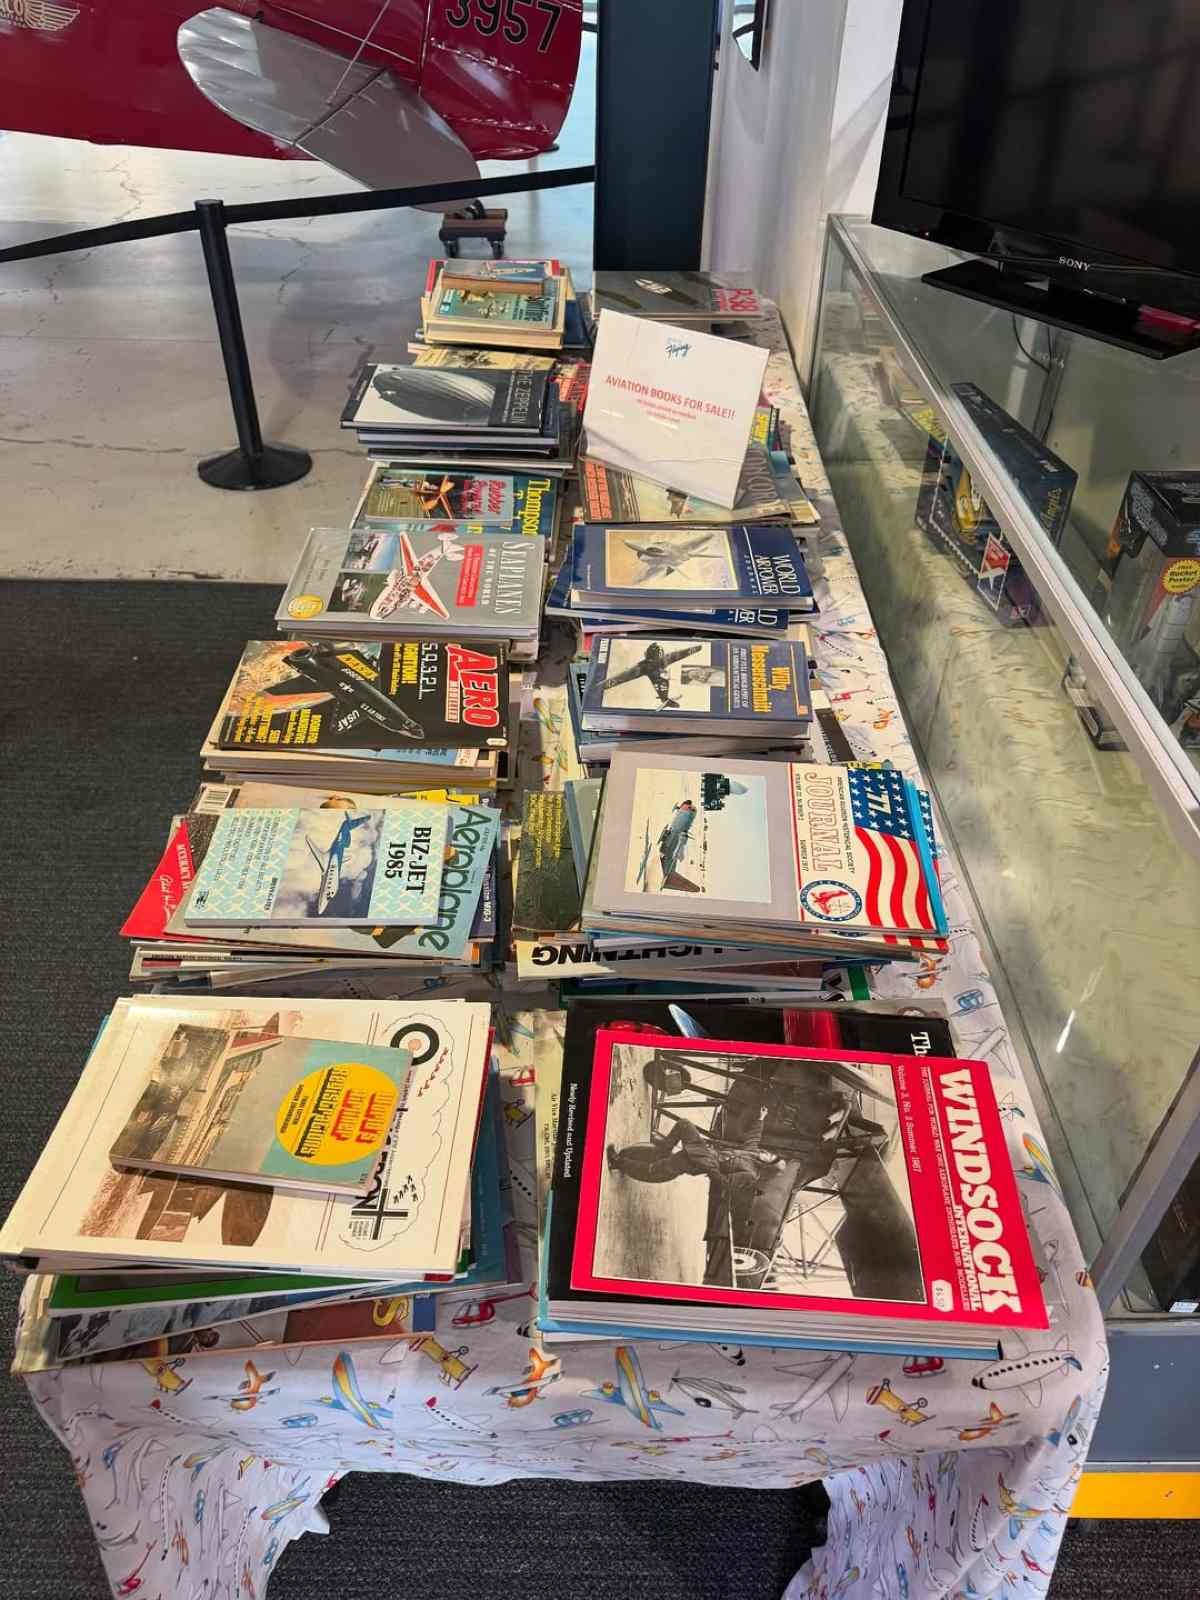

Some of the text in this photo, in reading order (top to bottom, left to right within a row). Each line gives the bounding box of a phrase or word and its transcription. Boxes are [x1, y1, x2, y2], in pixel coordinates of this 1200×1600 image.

[445, 0, 562, 53] 3957
[1058, 256, 1090, 271] SONY
[511, 387, 531, 424] ZEPPELIN
[606, 375, 649, 397] AVIATION
[650, 387, 682, 406] BOOKS
[683, 396, 703, 412] FOR
[704, 403, 736, 421] SALE!!
[481, 577, 494, 606] WORLD
[485, 560, 496, 575] THE
[494, 541, 536, 615] SEAPLANES
[772, 555, 800, 595] WORLD
[401, 643, 419, 684] IGNITION!
[446, 646, 499, 727] AERO
[751, 645, 773, 712] Messerschmitt
[769, 667, 791, 691] Willy
[337, 709, 360, 732] USAF
[804, 772, 843, 872] JOURNAL
[837, 776, 856, 874] AMERICAN AVIATION HISTORICAL SOCIETY
[385, 841, 407, 879] 1985
[418, 807, 492, 951] Aeroplane
[910, 1031, 932, 1058] Th
[562, 1083, 579, 1178] Newly Revised and Updated
[896, 1065, 907, 1091] Volume
[906, 1122, 918, 1153] Summer
[920, 1067, 928, 1078] THE
[929, 1116, 939, 1138] WORLD
[936, 1153, 944, 1167] ONE
[952, 1250, 962, 1266] AND
[939, 1069, 1023, 1313] WINDSOCK
[953, 1205, 982, 1311] INTERNATIONAL
